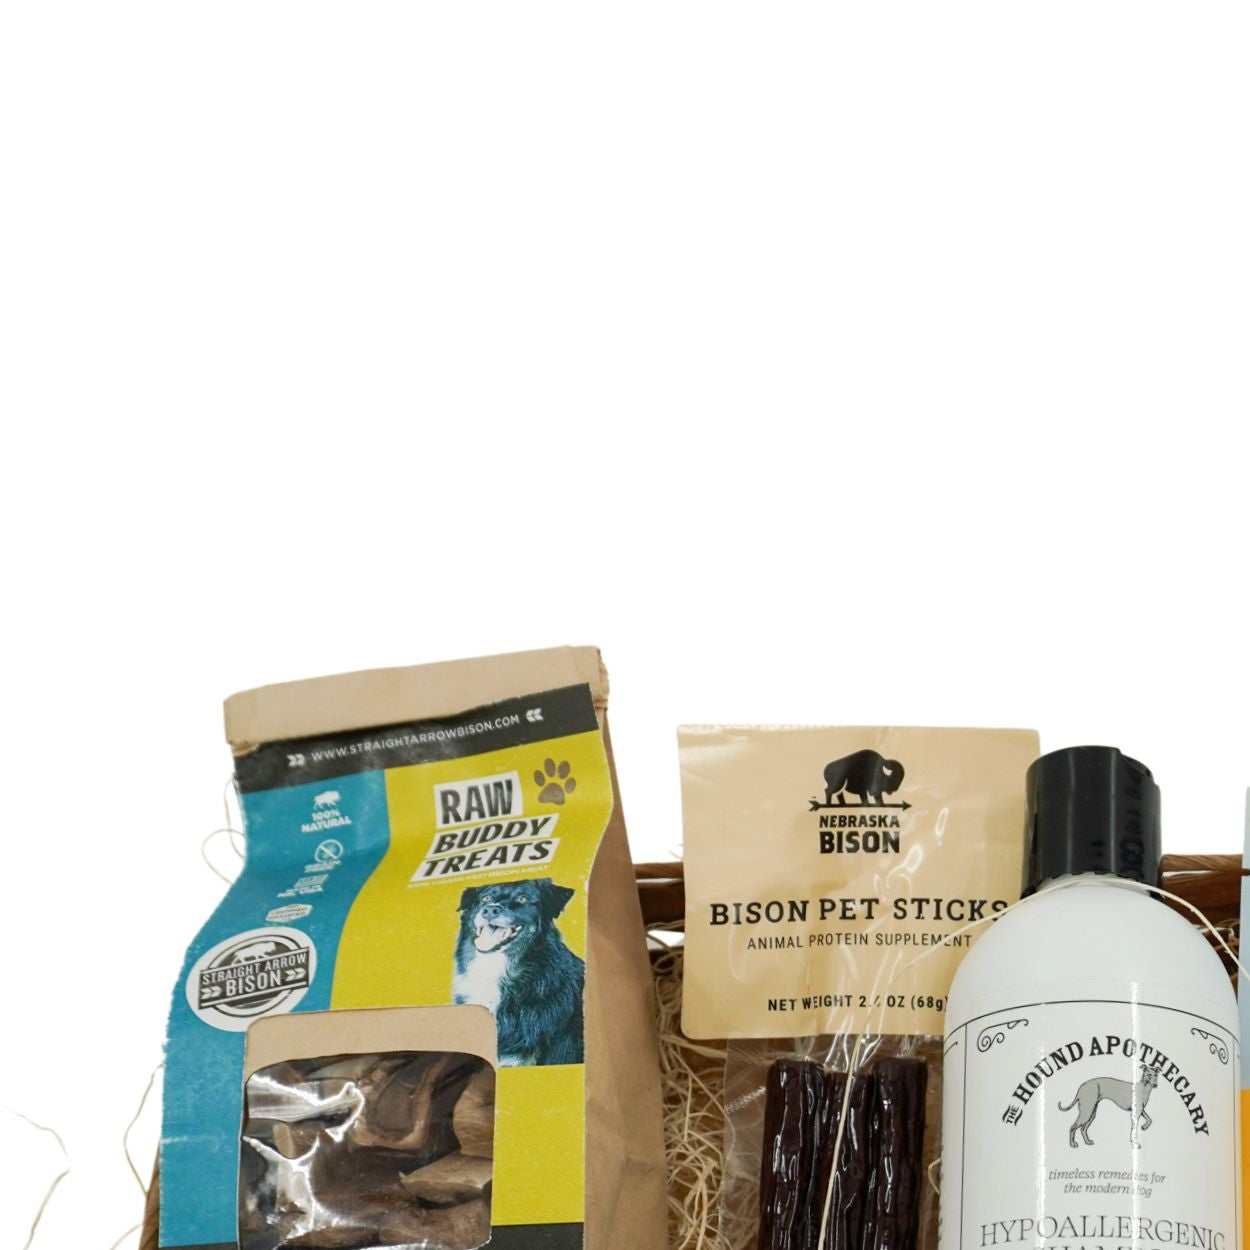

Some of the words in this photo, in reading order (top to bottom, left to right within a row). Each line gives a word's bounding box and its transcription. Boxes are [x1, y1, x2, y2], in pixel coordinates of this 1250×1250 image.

[311, 714, 520, 762] WWW.STRAIGHTARROWBISON.COM
[440, 779, 513, 825] RAW
[301, 816, 352, 833] NATURAL
[312, 809, 340, 822] 100%
[819, 815, 900, 828] NEBRASKA
[433, 816, 552, 855] BUDDY
[819, 831, 900, 854] BISON
[423, 840, 553, 877] TREATS
[710, 901, 809, 926] BISON
[818, 898, 880, 921] PET
[893, 898, 1009, 922] STICKS
[747, 935, 804, 950] ANIMAL
[809, 933, 869, 948] PROTEIN
[875, 933, 972, 948] SUPPLEMENT
[202, 962, 261, 985] STRAIGHT
[264, 952, 307, 972] ARROW
[225, 969, 282, 997] BISON
[768, 998, 798, 1011] NET
[801, 995, 853, 1010] WEIGHT
[887, 995, 905, 1009] OZ
[1012, 1041, 1084, 1105] HOUND
[1089, 1035, 1210, 1137] APOTHECARY
[1006, 1105, 1019, 1125] THE
[1048, 1168, 1095, 1180] timeless
[1098, 1169, 1149, 1182] remedes
[1150, 1172, 1167, 1185] for
[1064, 1182, 1082, 1194] the
[1085, 1182, 1130, 1195] modern
